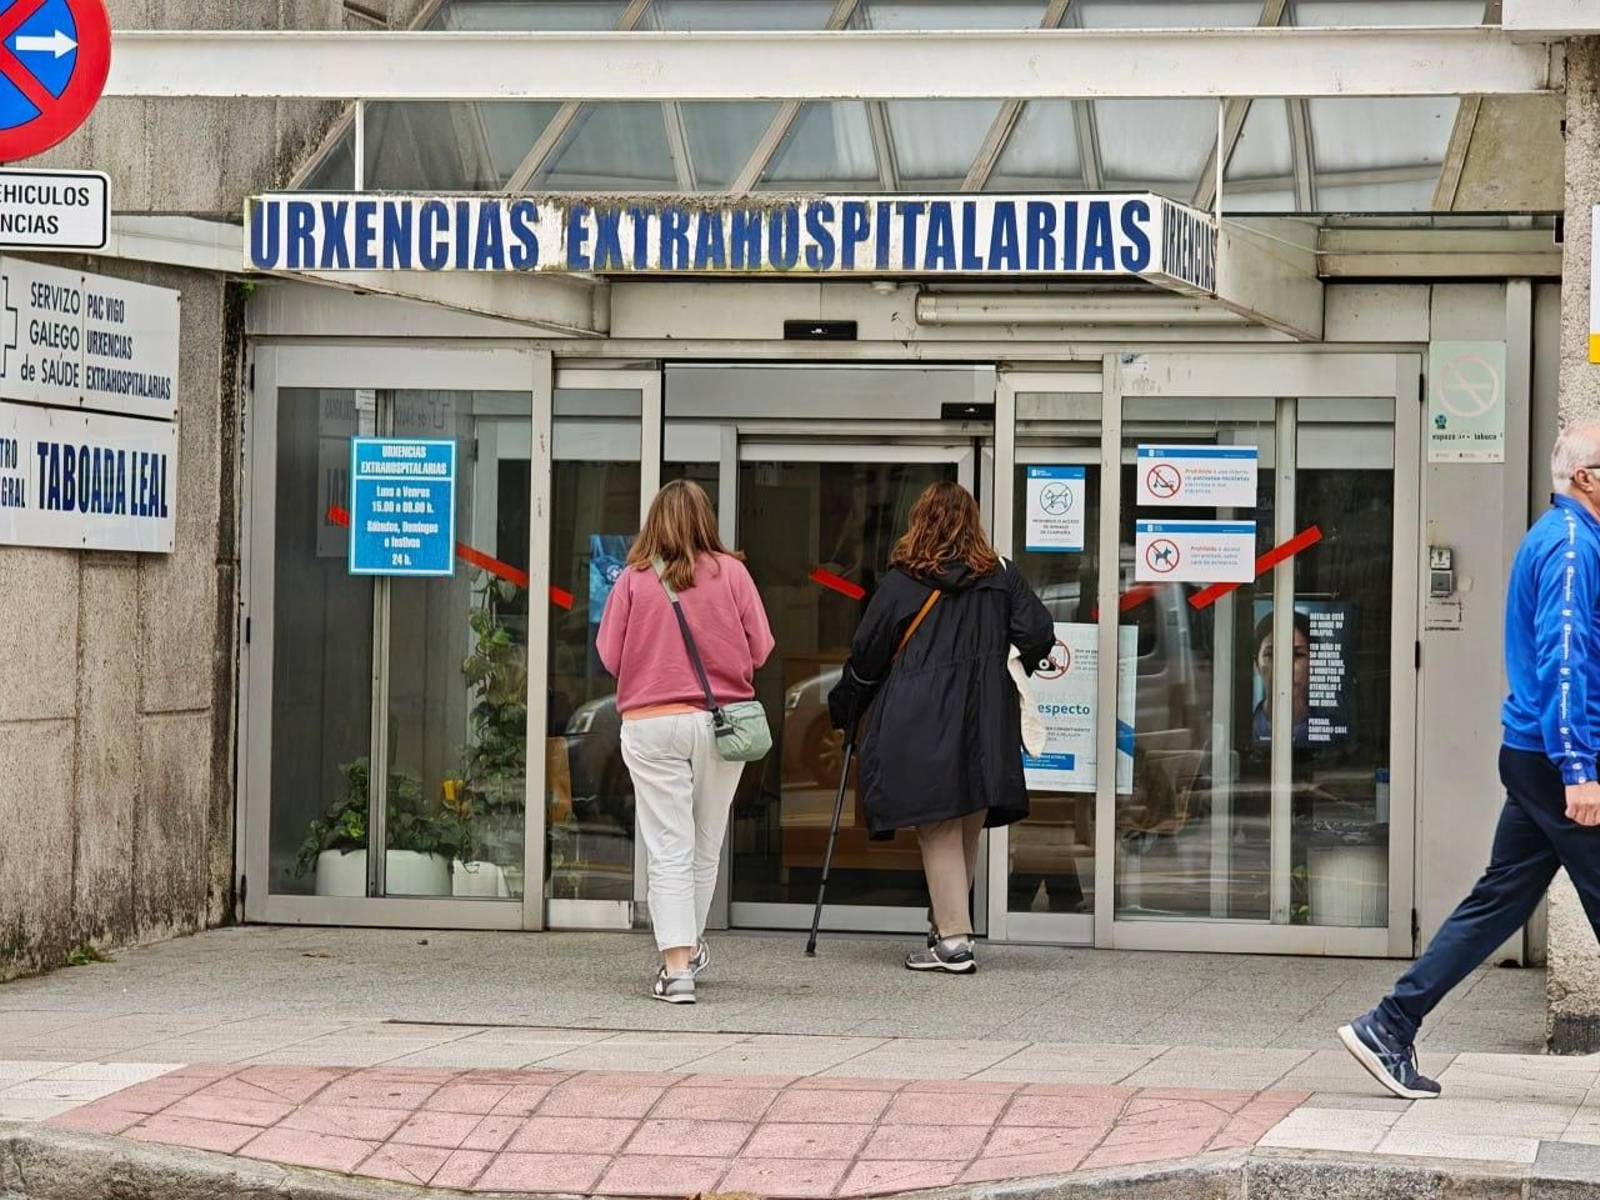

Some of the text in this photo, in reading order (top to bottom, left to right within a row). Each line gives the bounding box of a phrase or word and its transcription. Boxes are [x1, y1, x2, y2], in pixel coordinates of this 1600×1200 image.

[0, 184, 90, 206] HICULOS
[1, 213, 60, 234] NCIAS
[250, 199, 1151, 273] URXENCIAS EXTRAHOSPITALARIAS
[1161, 198, 1216, 293] URXENCIAS
[30, 281, 81, 315] SERVIZO
[87, 294, 125, 324] PAC VIGO
[29, 319, 80, 351] GALEGO
[86, 329, 133, 360] URXENCIAS
[20, 352, 80, 388] de SAÚDE
[86, 365, 171, 400] EXTRAHOSPITALARIAS
[381, 445, 427, 458] URXENCIAS
[37, 441, 168, 518] TABOADA LEAL
[360, 461, 447, 475] EXTRAHOSPITALARIAS
[391, 553, 403, 566] 24
[1037, 704, 1091, 716] especto
